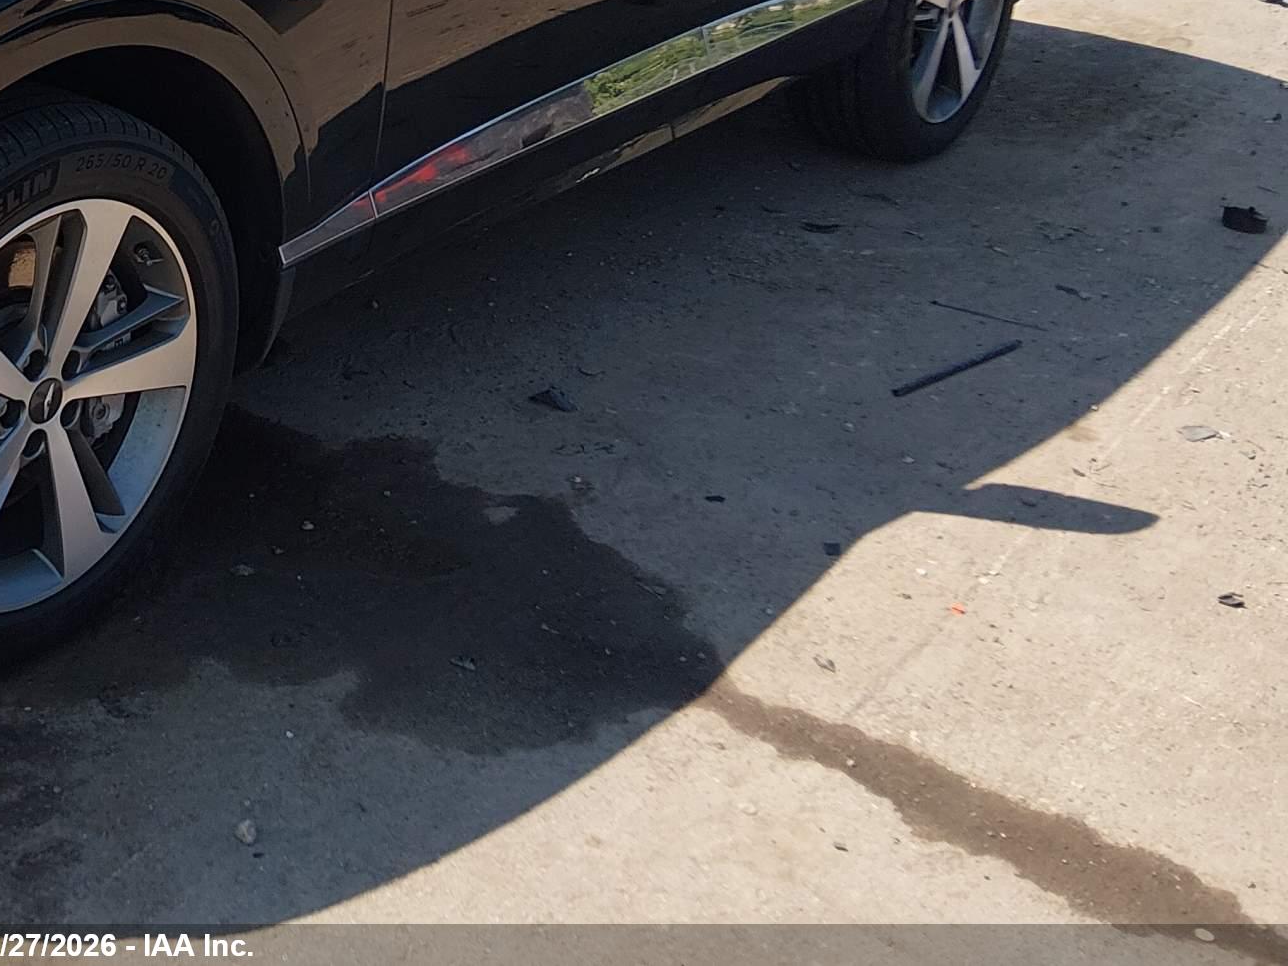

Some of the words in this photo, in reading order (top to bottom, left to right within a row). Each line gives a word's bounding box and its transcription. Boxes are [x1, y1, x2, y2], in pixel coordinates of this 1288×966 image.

[75, 153, 132, 172] 265/50
[135, 156, 147, 171] R
[147, 162, 168, 180] 20
